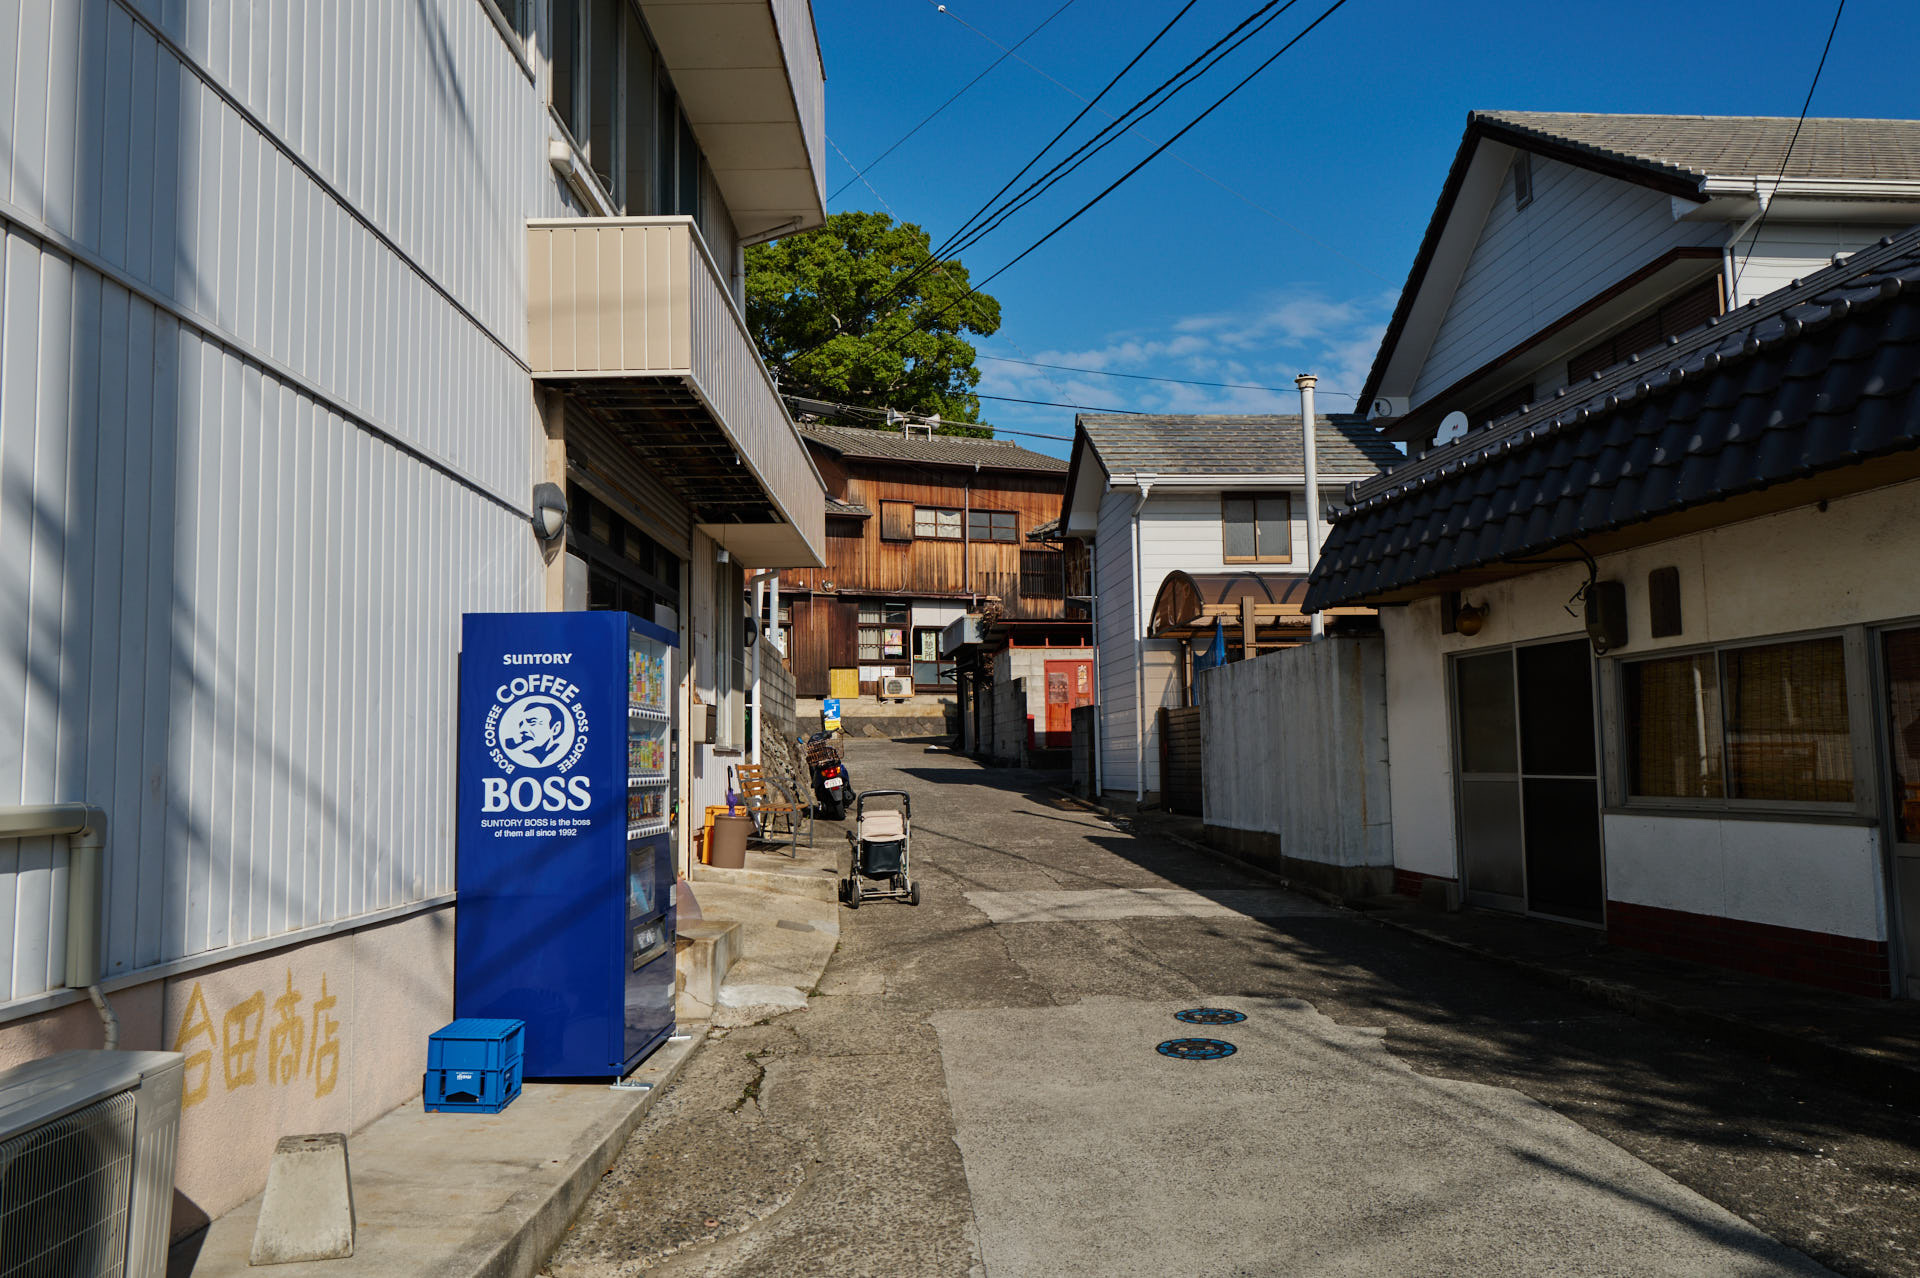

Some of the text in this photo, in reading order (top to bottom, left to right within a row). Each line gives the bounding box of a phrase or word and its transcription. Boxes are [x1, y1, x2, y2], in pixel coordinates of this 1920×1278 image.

[503, 653, 573, 665] SUNTORY
[496, 674, 580, 704] COFFEE
[484, 704, 516, 775] BOSS COFFEE
[557, 702, 589, 774] BOSS COFFEE
[481, 775, 592, 813] BOSS
[480, 818, 591, 828] SUNTORY BOSS is the boss
[494, 828, 577, 838] of them all since 1992
[174, 966, 340, 1112] 合田商店
